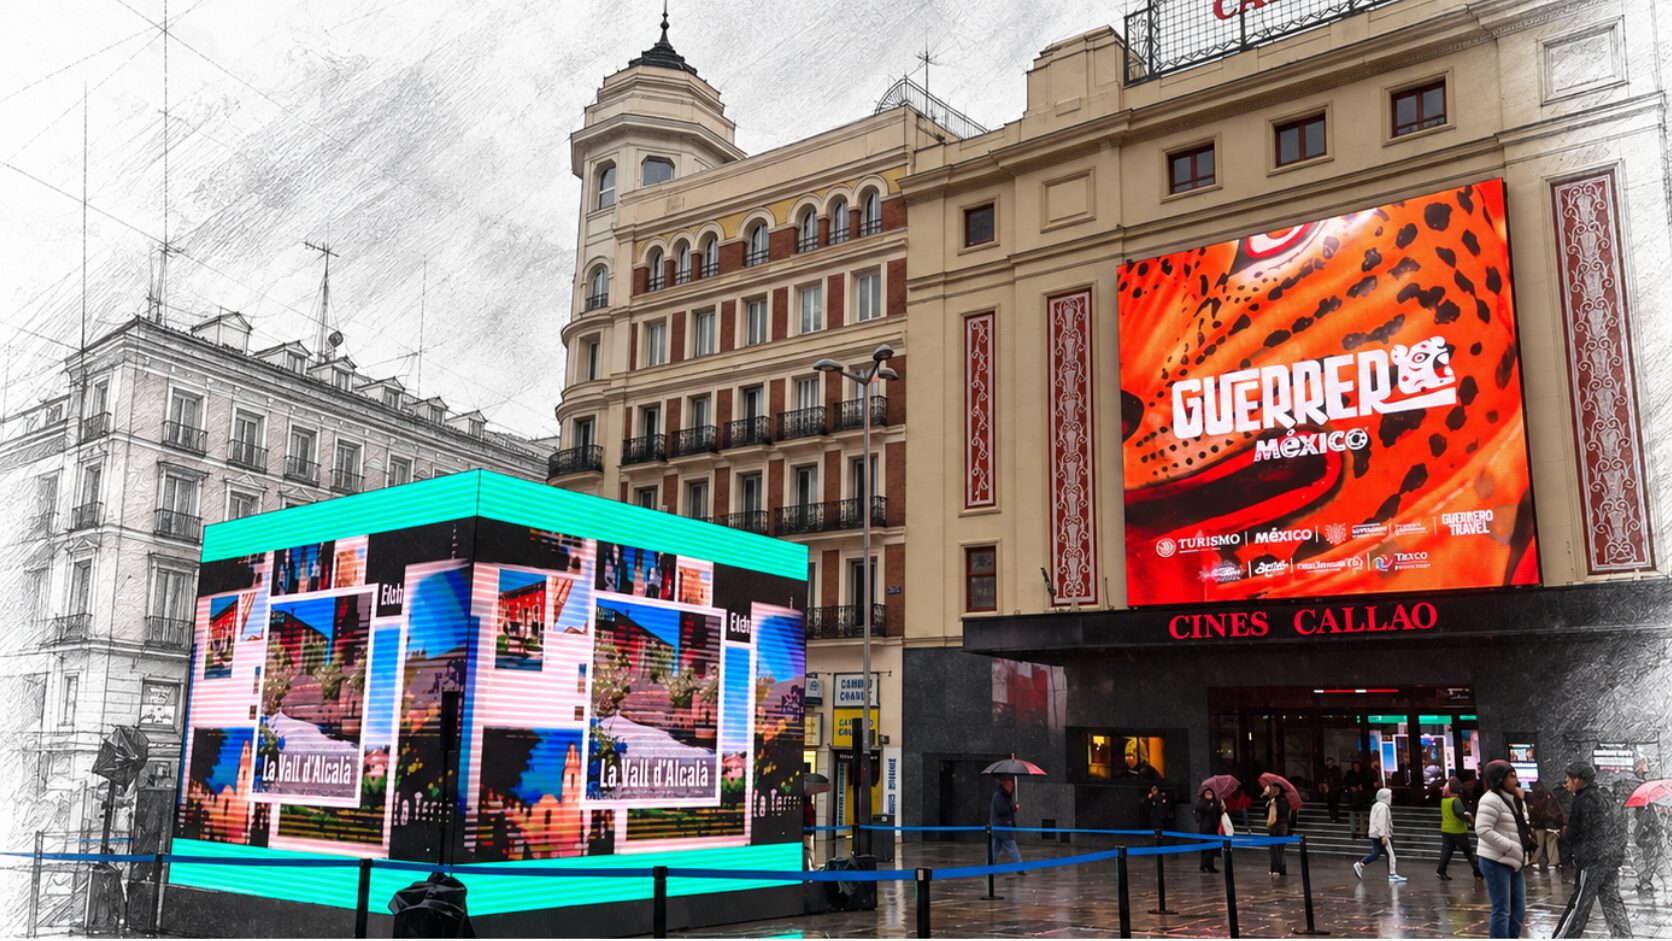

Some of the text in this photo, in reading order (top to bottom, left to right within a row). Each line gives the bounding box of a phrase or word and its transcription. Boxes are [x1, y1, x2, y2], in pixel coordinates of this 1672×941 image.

[1178, 533, 1241, 550] TURISMO
[1449, 520, 1490, 537] TRAVEL
[1168, 602, 1438, 640] CINES CALLAO
[262, 753, 276, 782] La
[278, 753, 300, 783] Vall
[600, 757, 709, 788] La Vall d'Alcalà
